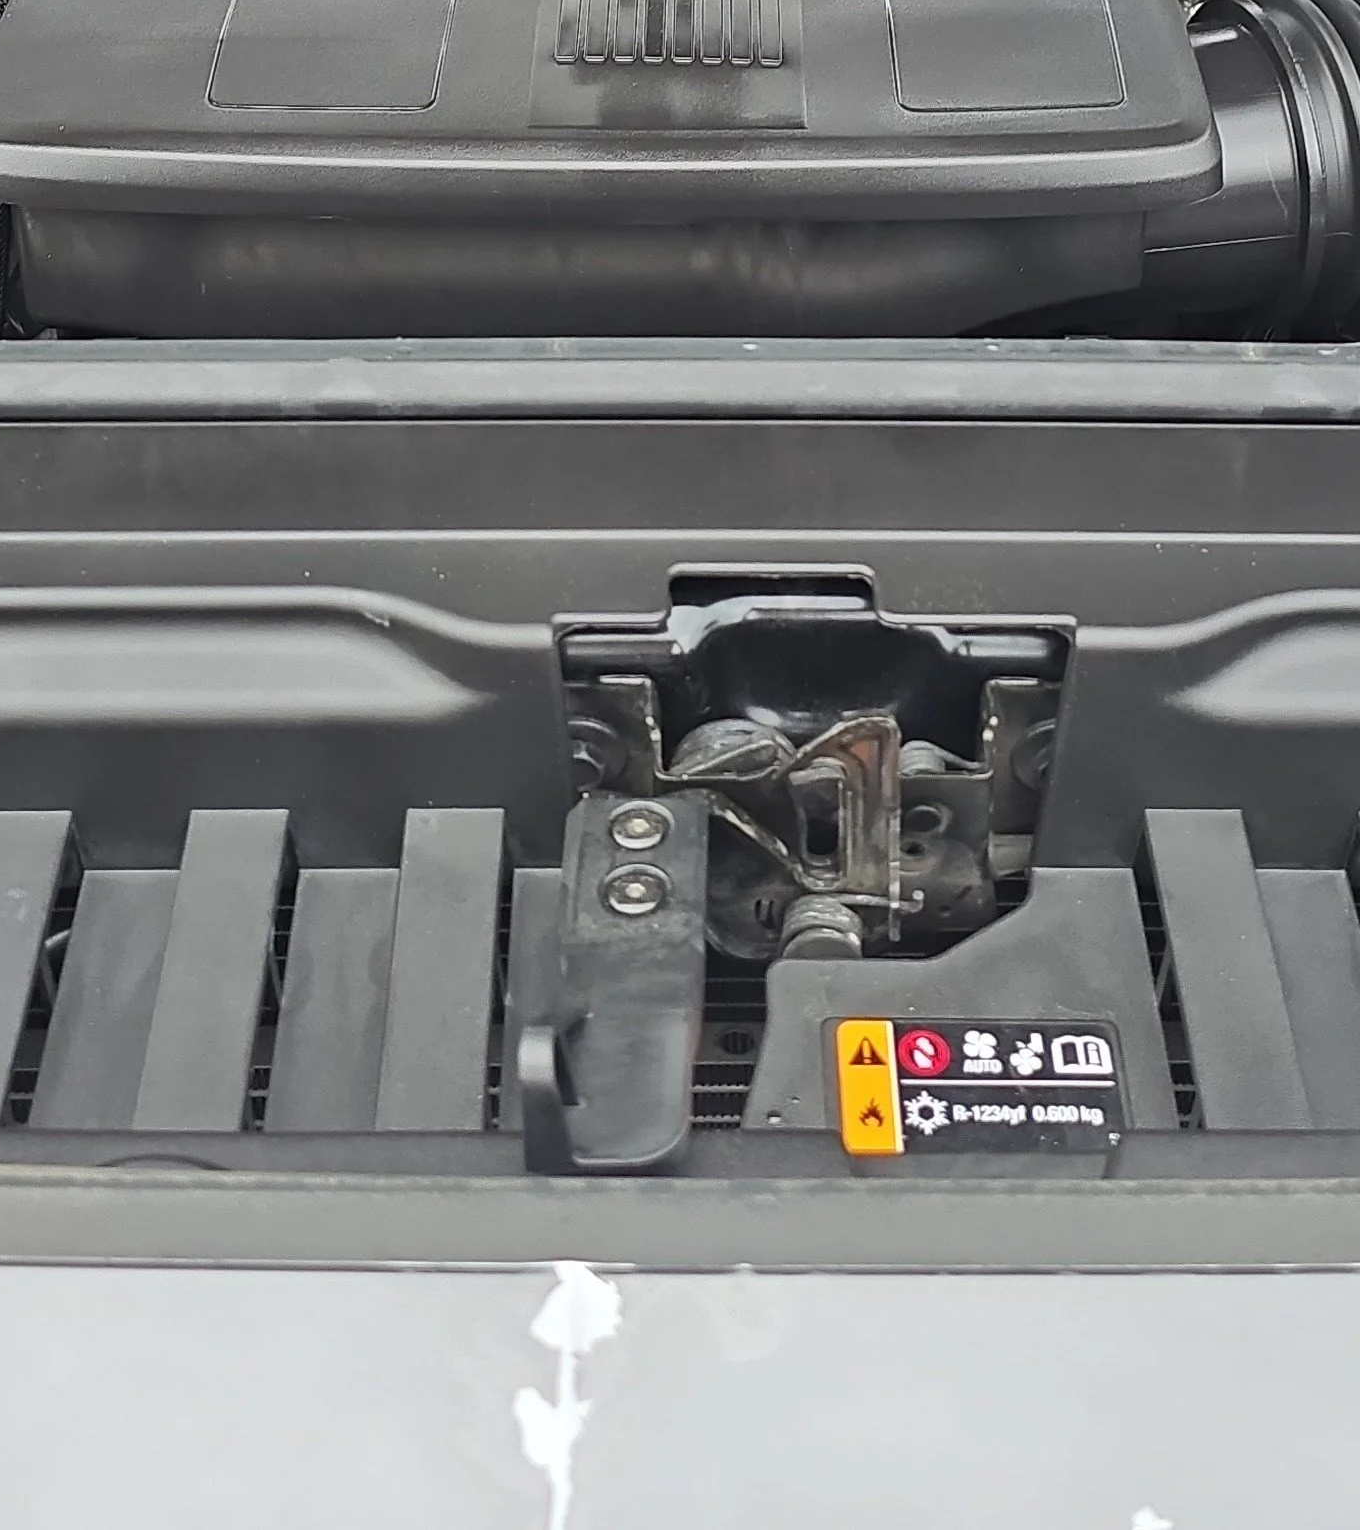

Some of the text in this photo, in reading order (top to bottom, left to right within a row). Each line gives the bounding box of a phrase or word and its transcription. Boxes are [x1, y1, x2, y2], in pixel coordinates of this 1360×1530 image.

[963, 1059, 1003, 1074] AUTO
[953, 1104, 1105, 1126] R-1234yf 0.600 kg
